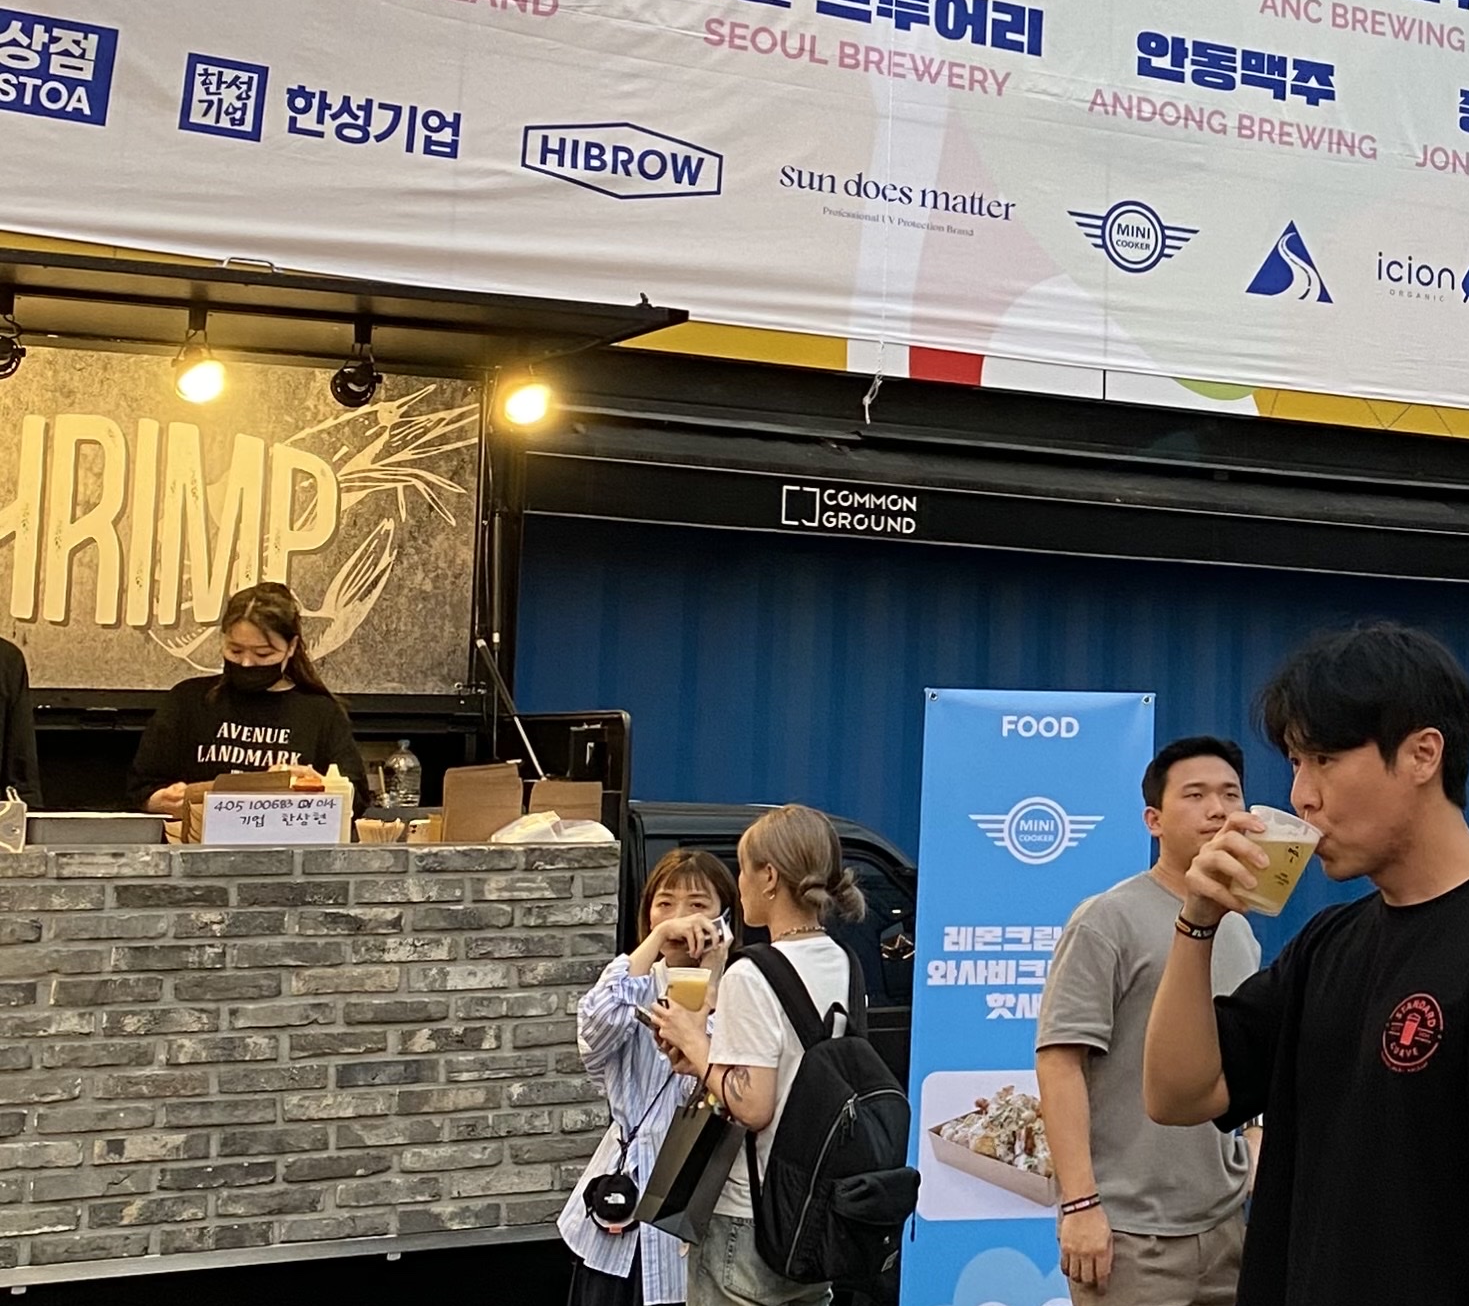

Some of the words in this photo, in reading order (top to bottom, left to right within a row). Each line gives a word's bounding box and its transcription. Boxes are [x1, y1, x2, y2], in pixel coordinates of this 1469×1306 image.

[1331, 2, 1466, 53] BREWING
[702, 17, 829, 67] SEOUL
[837, 39, 1012, 97] BREWERY
[1136, 30, 1336, 107] 안동맥주
[197, 66, 254, 102] 한성
[197, 98, 249, 128] 기업
[286, 83, 463, 160] 한성기업
[1087, 88, 1228, 136] ANDONG
[1236, 113, 1378, 161] BREWING
[539, 134, 706, 187] HIBROW
[779, 164, 838, 196] sun
[843, 171, 914, 206] does
[919, 187, 1017, 223] matter
[1115, 238, 1152, 252] COOKER
[1116, 222, 1152, 240] MINI
[1376, 250, 1456, 291] icion
[1388, 288, 1446, 304] ORGANIC
[823, 489, 917, 512] COMMON
[822, 512, 917, 534] GROUND
[217, 722, 291, 745] AVENUE
[1000, 714, 1080, 740] FOOD
[197, 744, 302, 768] LANDMARK
[1017, 833, 1055, 844] COOKER
[1018, 818, 1055, 833] MINI
